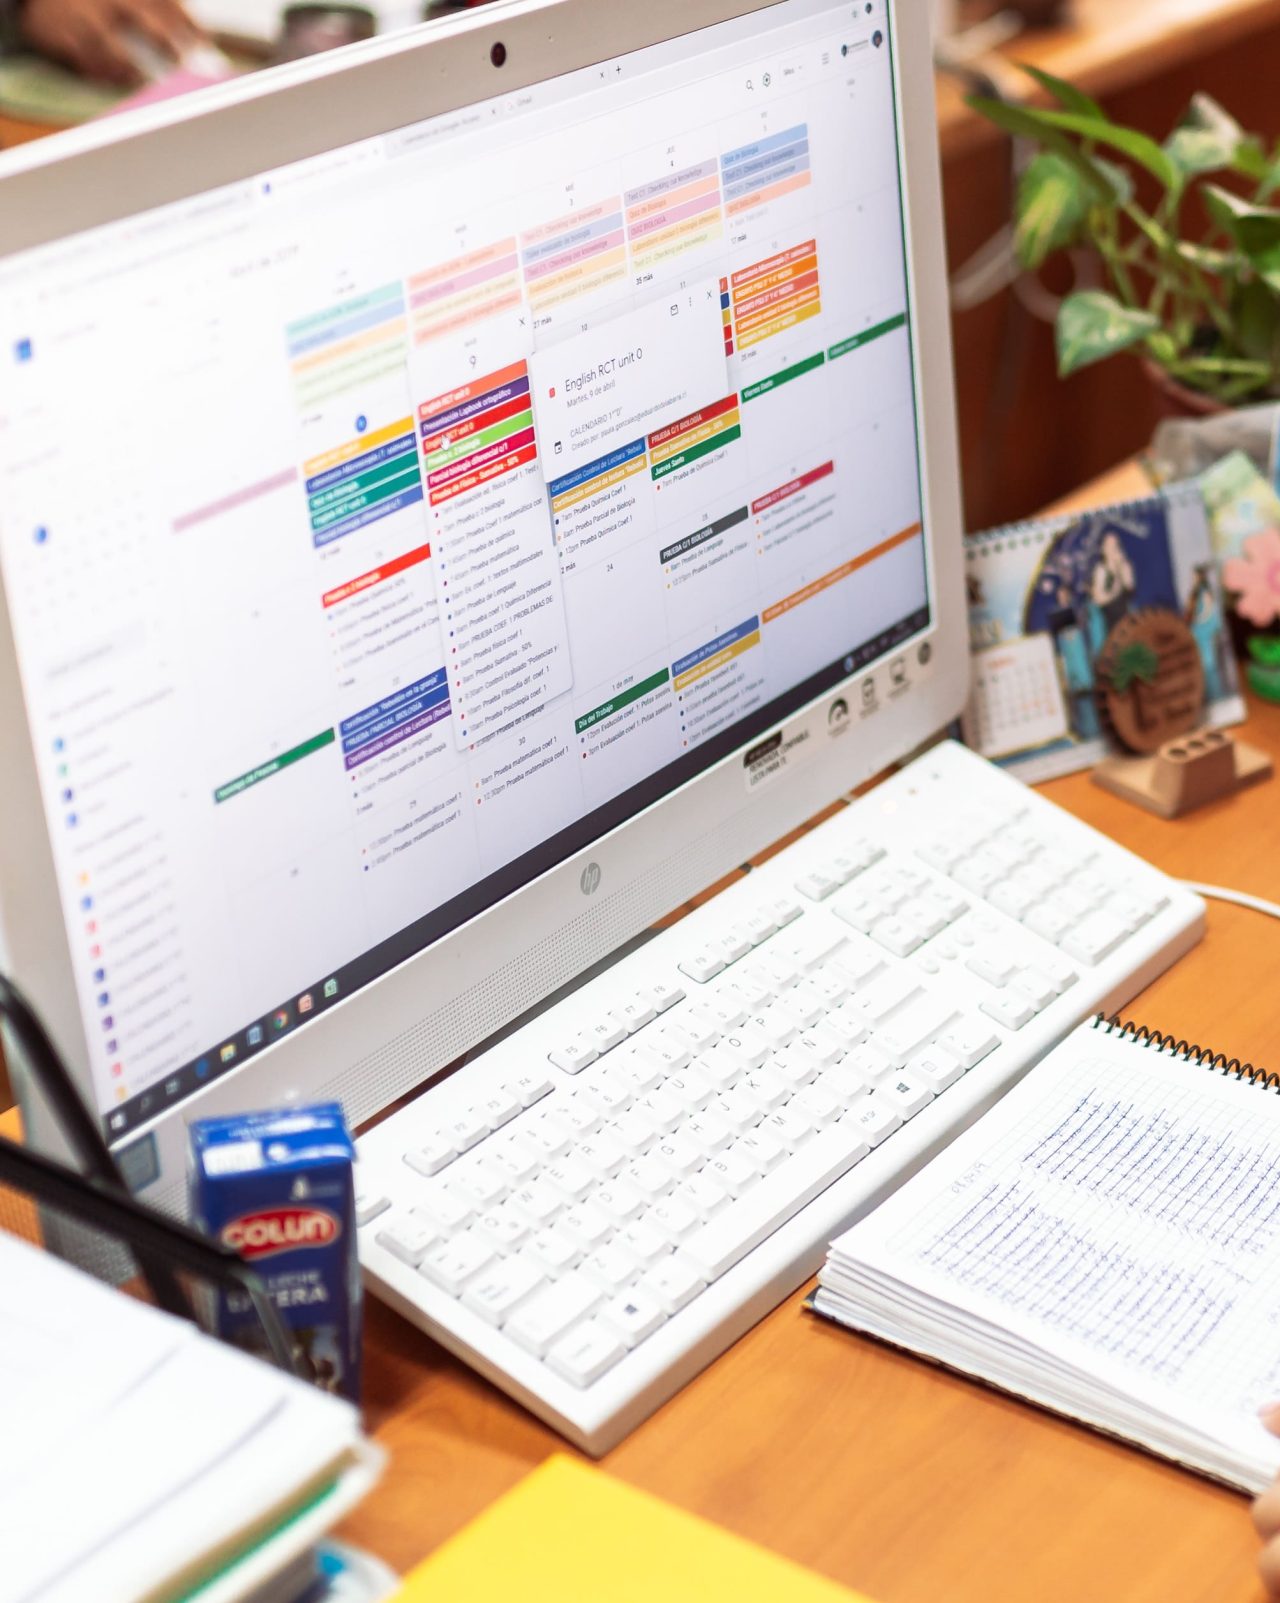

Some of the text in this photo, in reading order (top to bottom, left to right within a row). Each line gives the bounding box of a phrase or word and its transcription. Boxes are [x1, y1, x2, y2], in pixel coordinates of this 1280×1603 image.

[469, 354, 476, 367] 9
[565, 368, 596, 395] English
[597, 358, 616, 378] RCT
[617, 349, 635, 369] unit
[570, 413, 607, 438] CALENDARIO
[606, 562, 613, 572] 24
